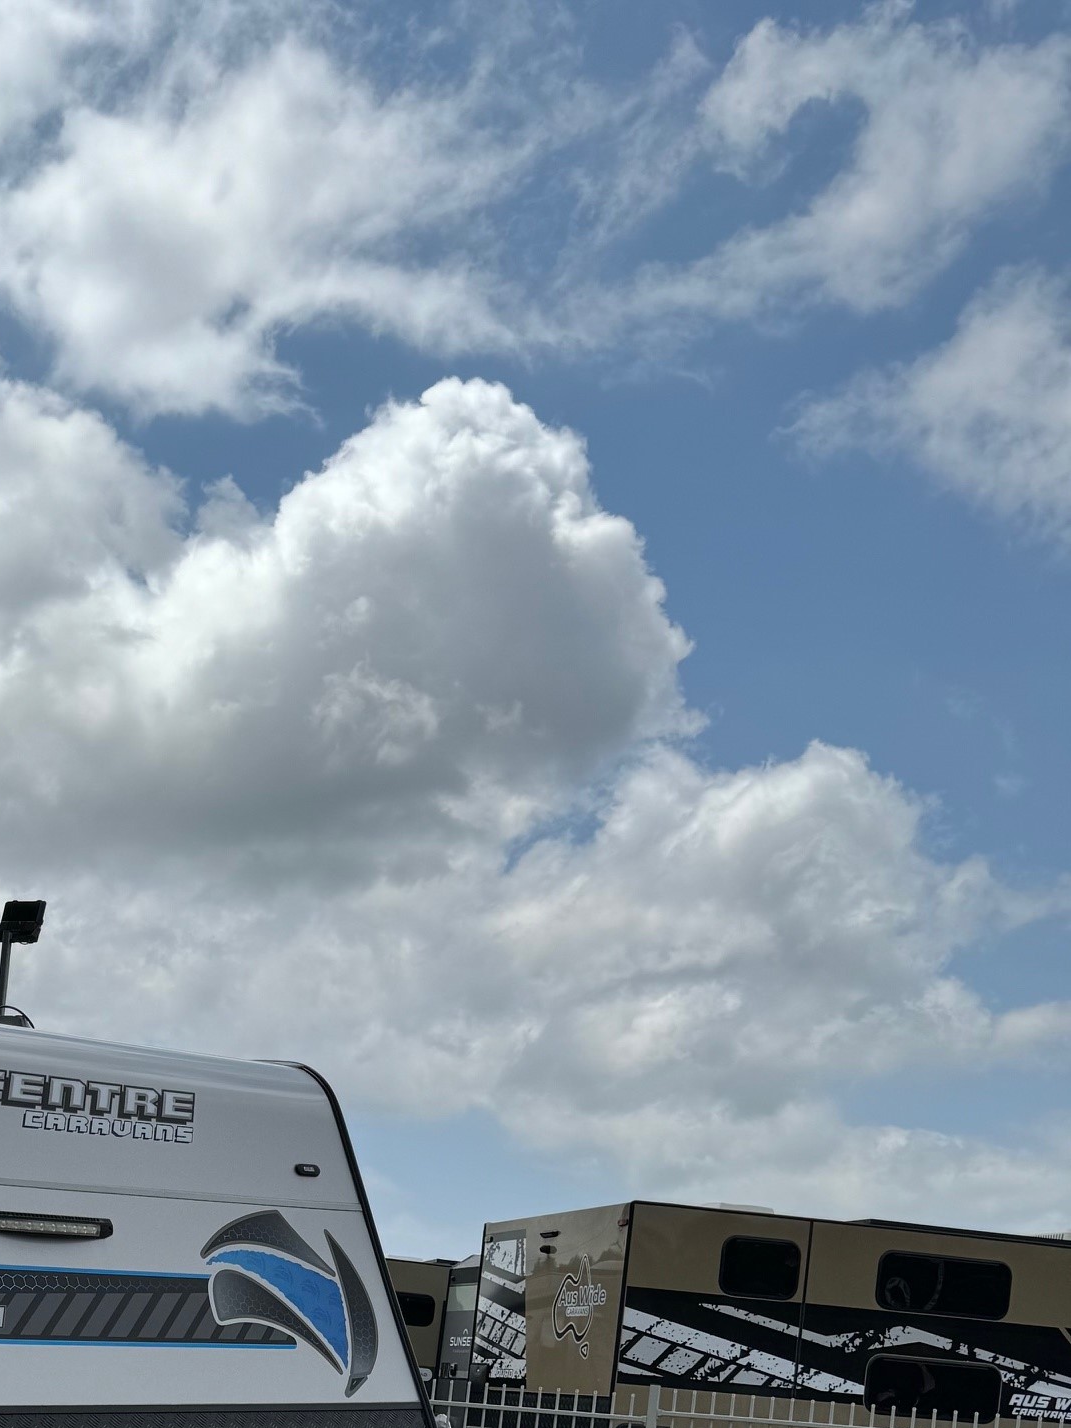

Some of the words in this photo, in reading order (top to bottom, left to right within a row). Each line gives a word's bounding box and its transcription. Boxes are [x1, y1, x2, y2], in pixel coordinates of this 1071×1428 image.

[22, 1109, 194, 1143] CARAVANS
[558, 1286, 578, 1306] Aus
[579, 1284, 606, 1305] Wide
[1009, 1394, 1051, 1409] AUS
[1055, 1397, 1071, 1412] W
